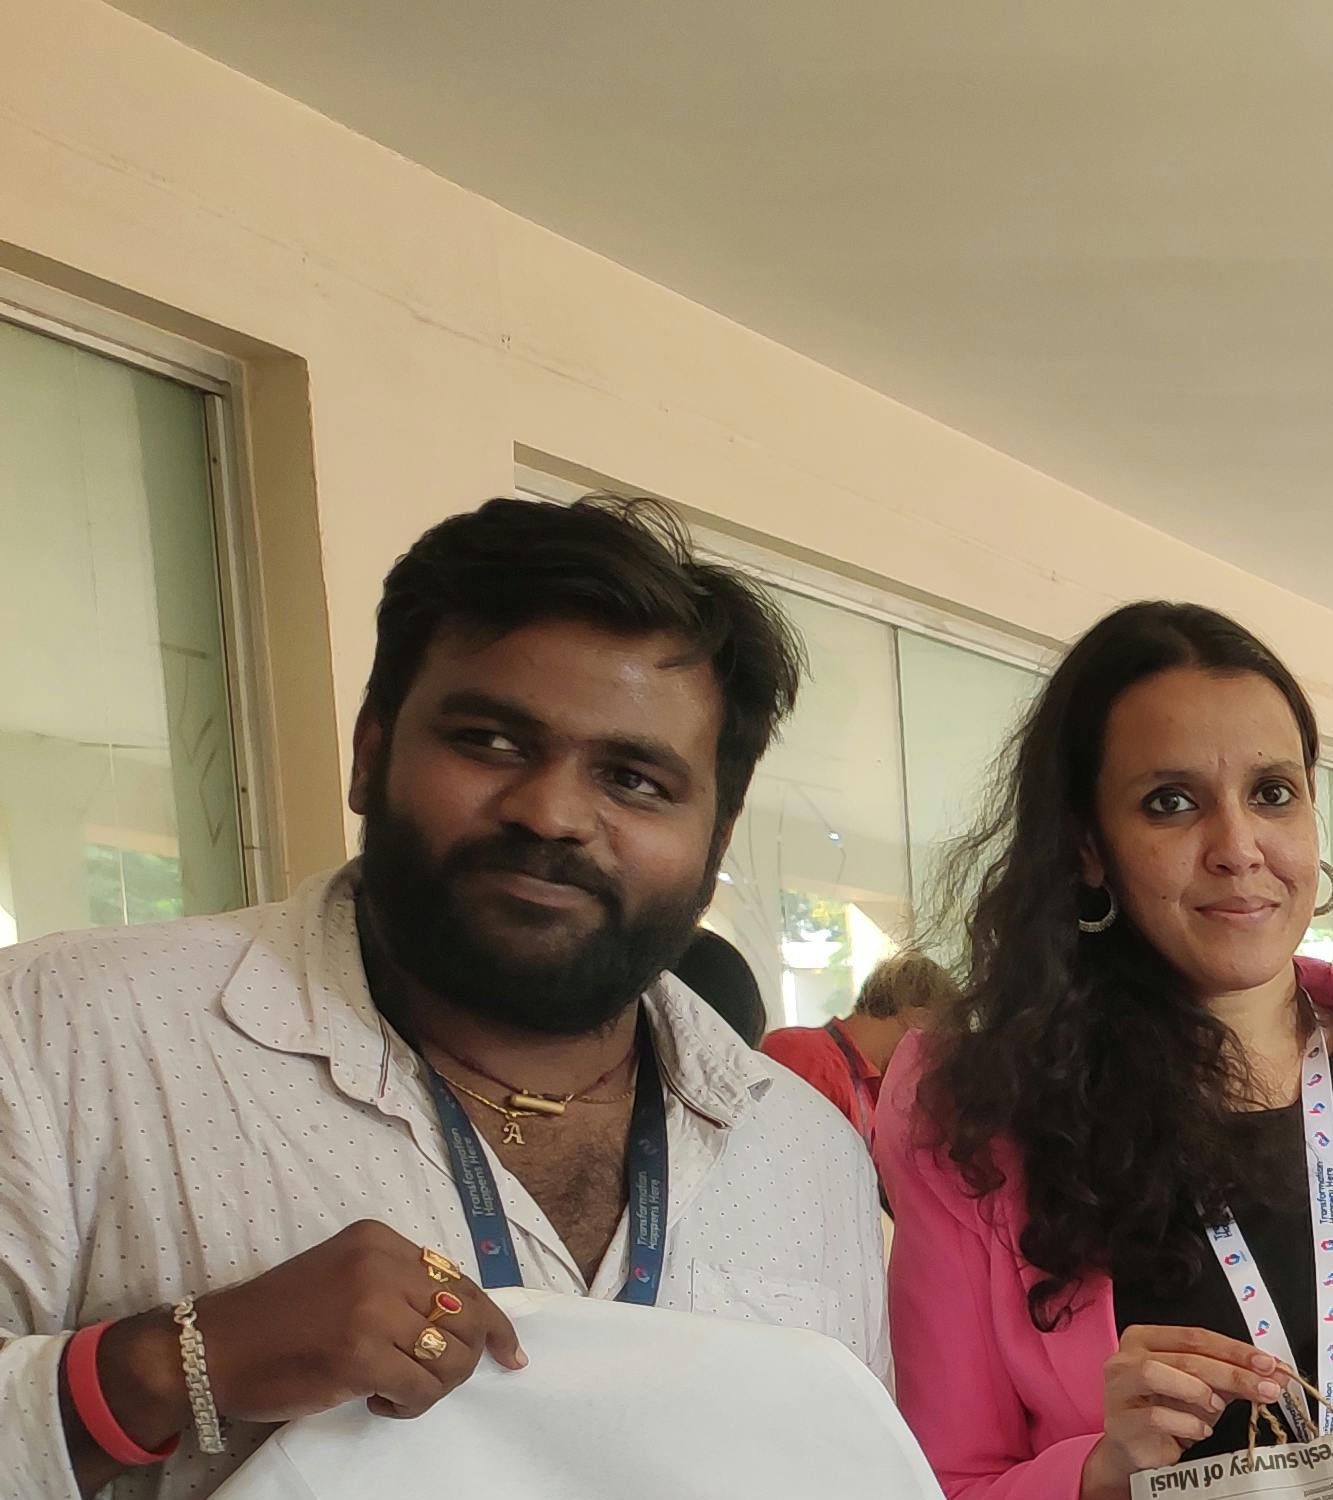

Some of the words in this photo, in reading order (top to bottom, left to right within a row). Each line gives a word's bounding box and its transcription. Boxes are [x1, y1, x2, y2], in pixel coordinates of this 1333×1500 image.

[452, 1127, 483, 1216] Transformation
[473, 1163, 496, 1217] Happens
[651, 1178, 660, 1206] Here
[1319, 1159, 1328, 1226] Transformation
[637, 1171, 647, 1246] Transformation
[1149, 1468, 1200, 1498] Musi
[1199, 1461, 1223, 1484] of
[1229, 1449, 1300, 1476] survey
